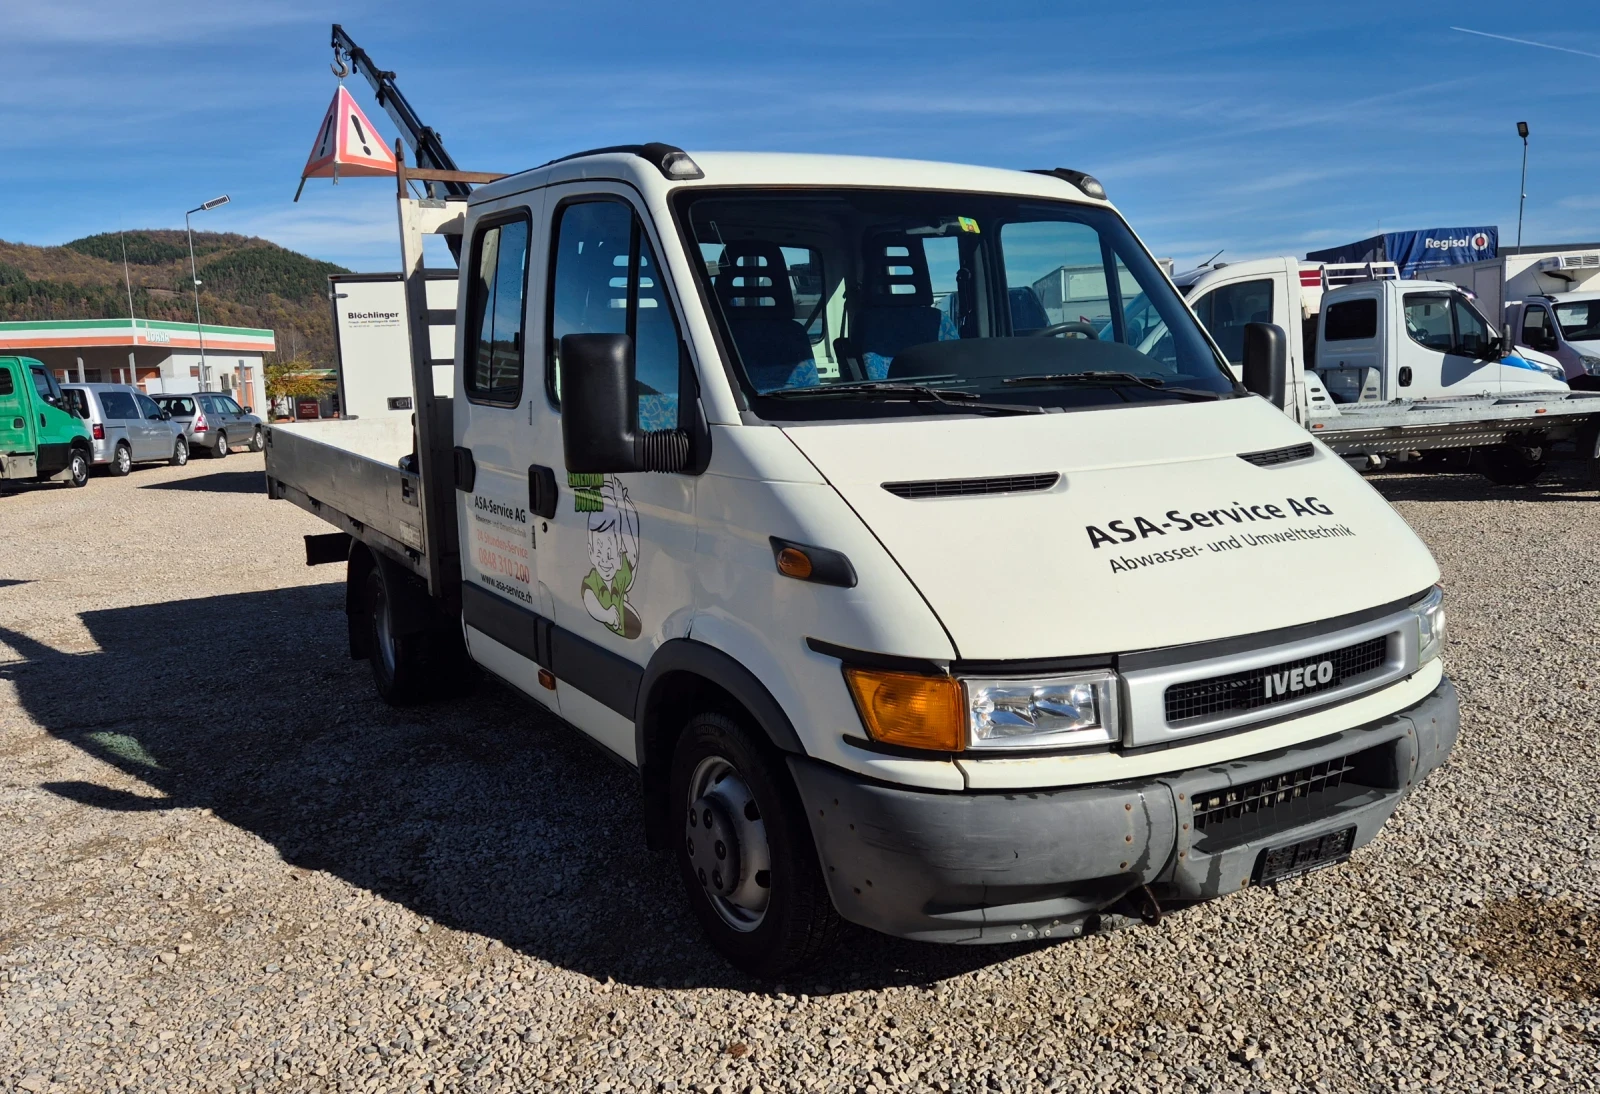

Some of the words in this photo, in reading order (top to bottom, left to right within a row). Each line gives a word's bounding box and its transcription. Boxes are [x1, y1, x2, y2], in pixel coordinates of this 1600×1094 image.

[1425, 236, 1469, 250] Regisol
[347, 311, 399, 320] Blöchlinger
[475, 495, 513, 520] ASA-Service
[515, 507, 526, 524] AG
[1085, 501, 1286, 549] ASA-Service
[1286, 496, 1334, 517] AG
[479, 547, 497, 570] 0848
[498, 554, 512, 577] 310
[515, 561, 530, 584] 200
[1109, 545, 1203, 573] Abwasser-
[1205, 536, 1242, 553] und
[1240, 524, 1356, 547] Umwelttechnik
[480, 572, 533, 604] www.asa-service.ch
[1265, 660, 1333, 699] IVECO
